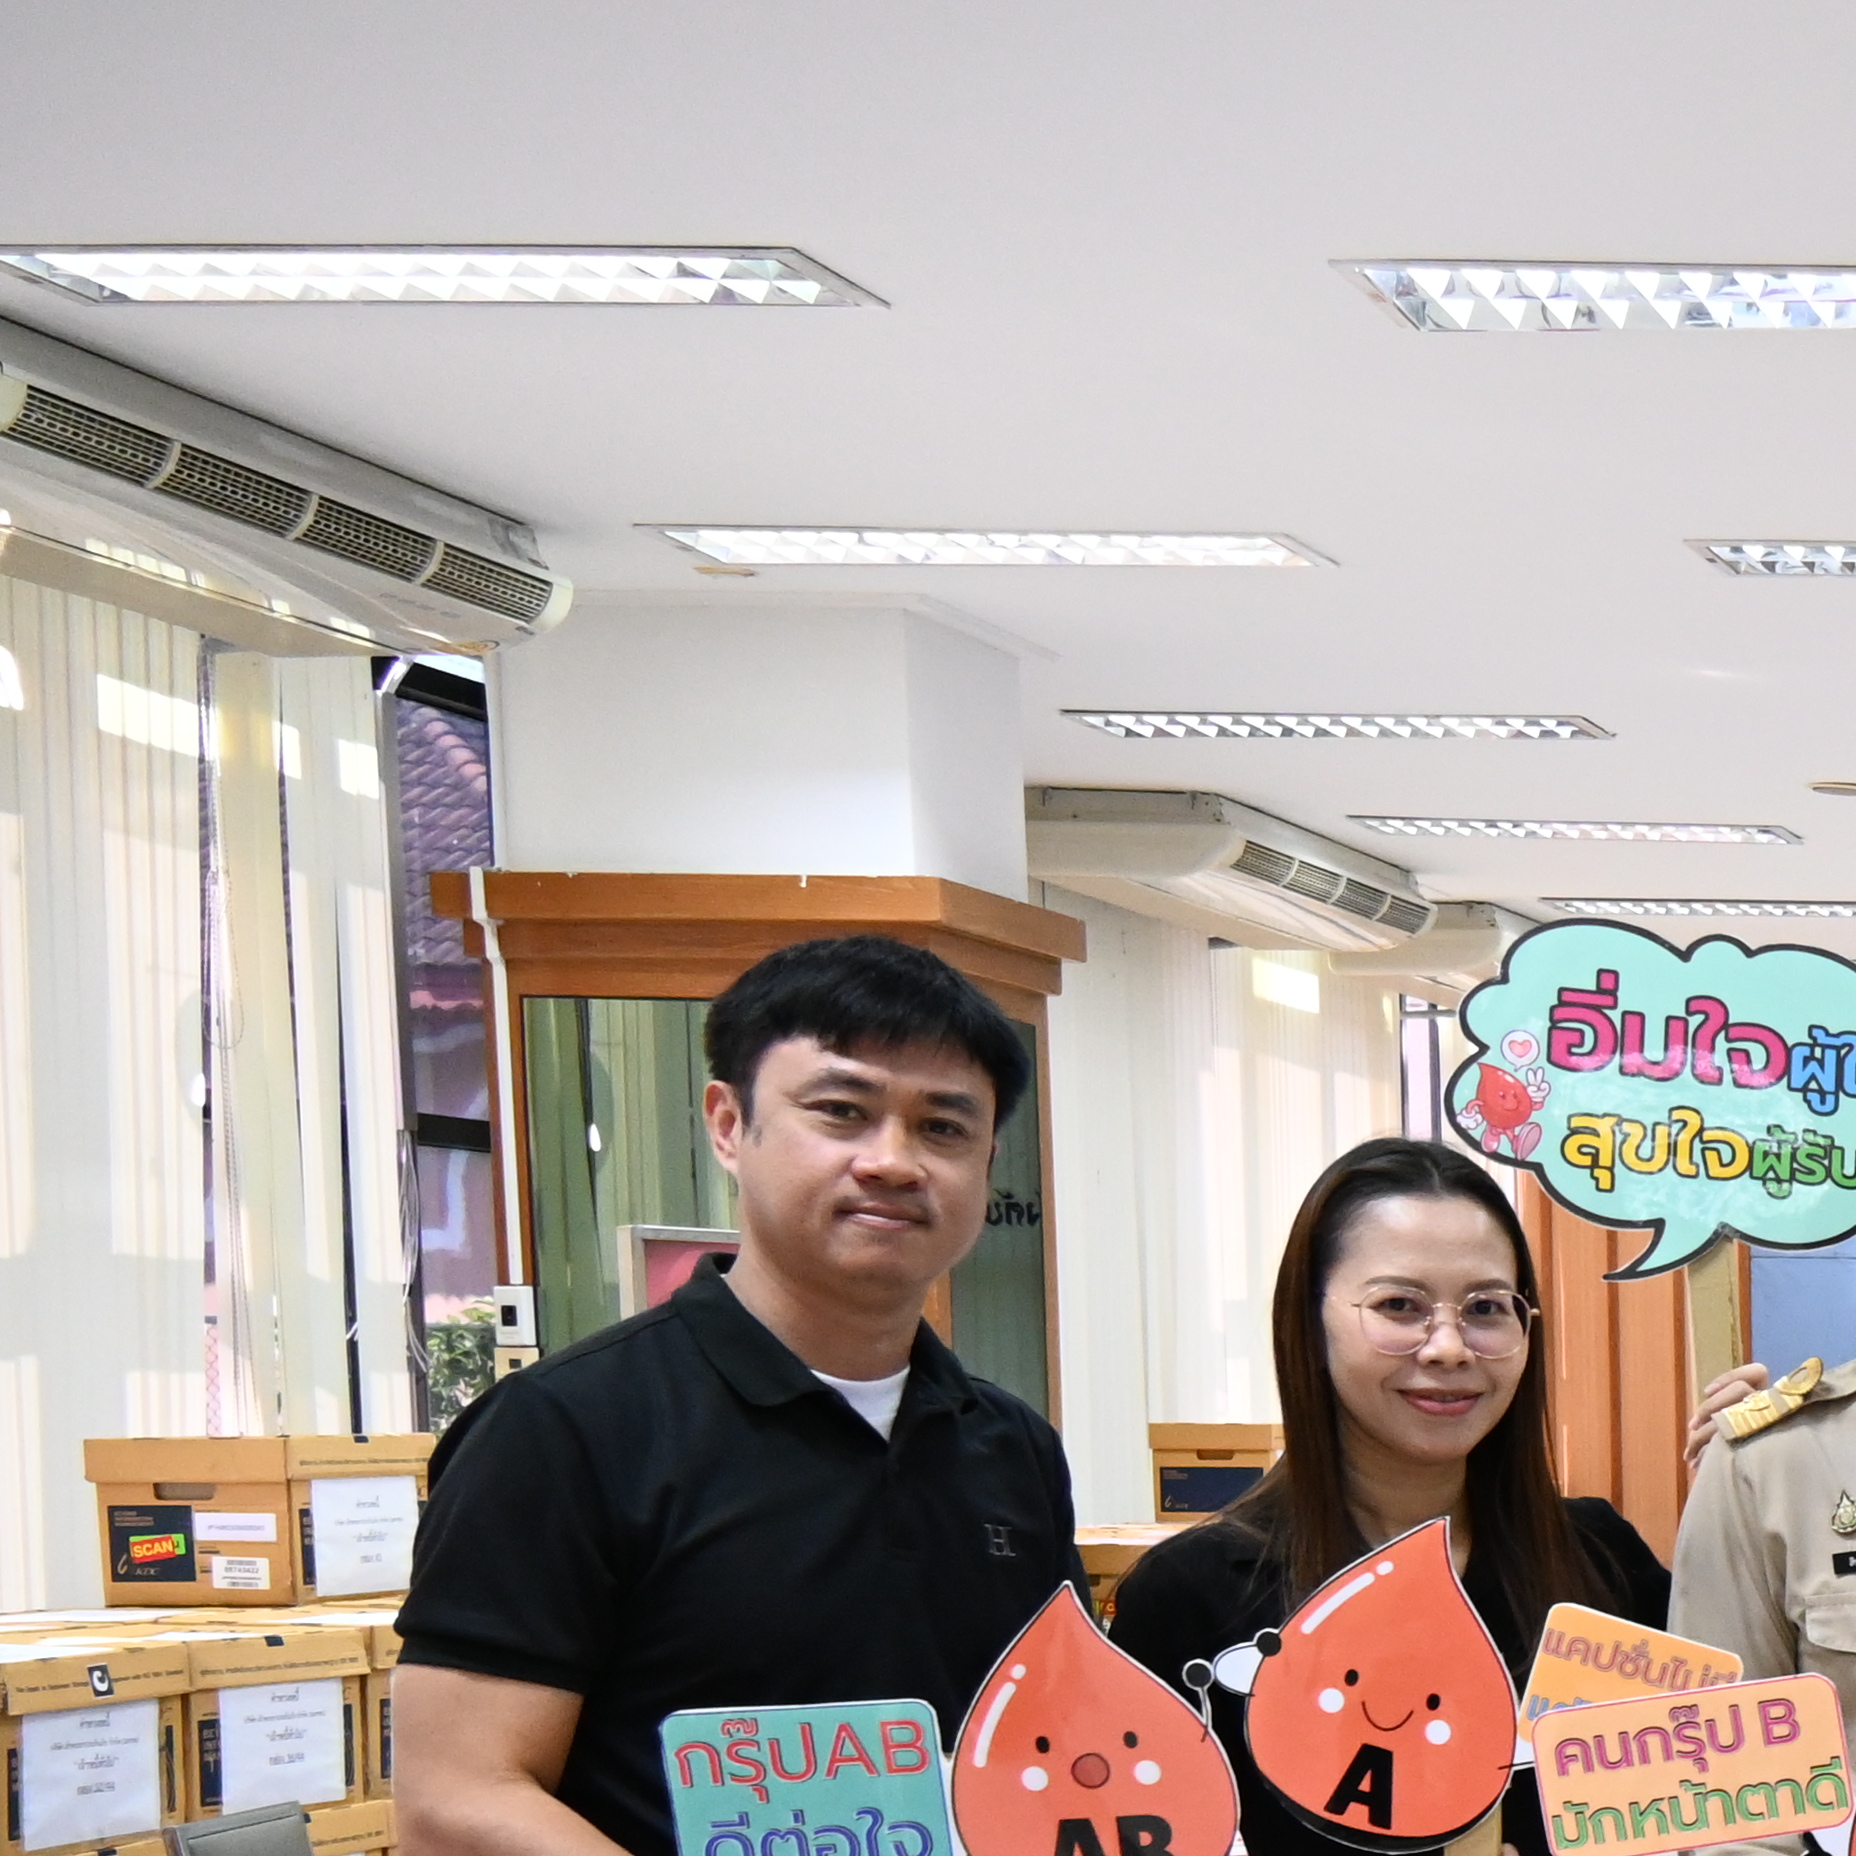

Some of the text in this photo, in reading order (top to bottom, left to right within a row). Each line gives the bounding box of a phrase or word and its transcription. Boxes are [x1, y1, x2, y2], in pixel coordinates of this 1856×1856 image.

[132, 1538, 174, 1558] SCAN
[1325, 1743, 1394, 1830] A
[1552, 1756, 1850, 1851] มักหน้าตาดี
